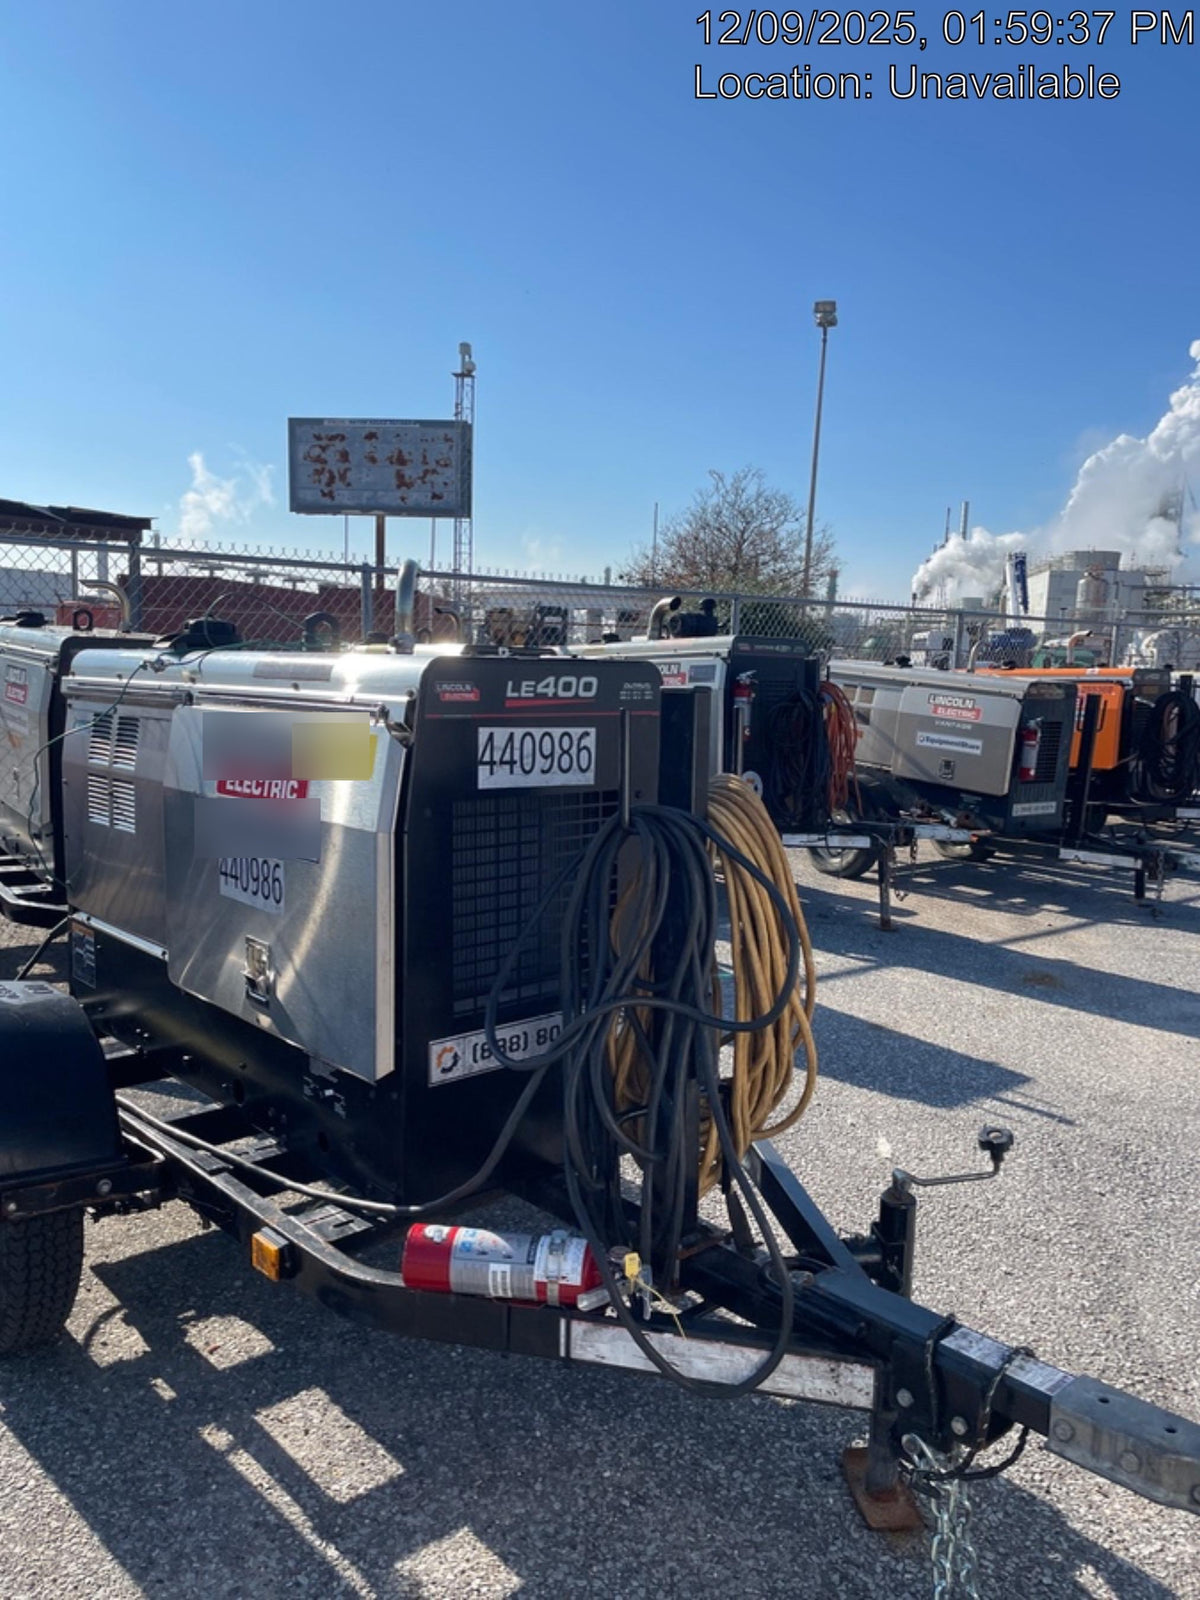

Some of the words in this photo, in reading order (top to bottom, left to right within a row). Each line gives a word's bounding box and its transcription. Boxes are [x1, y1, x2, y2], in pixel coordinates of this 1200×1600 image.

[505, 676, 598, 698] LE400
[929, 694, 974, 709] LINCOLN
[936, 707, 977, 719] ELECTRIC
[478, 731, 592, 776] 440986
[219, 857, 283, 905] 440986
